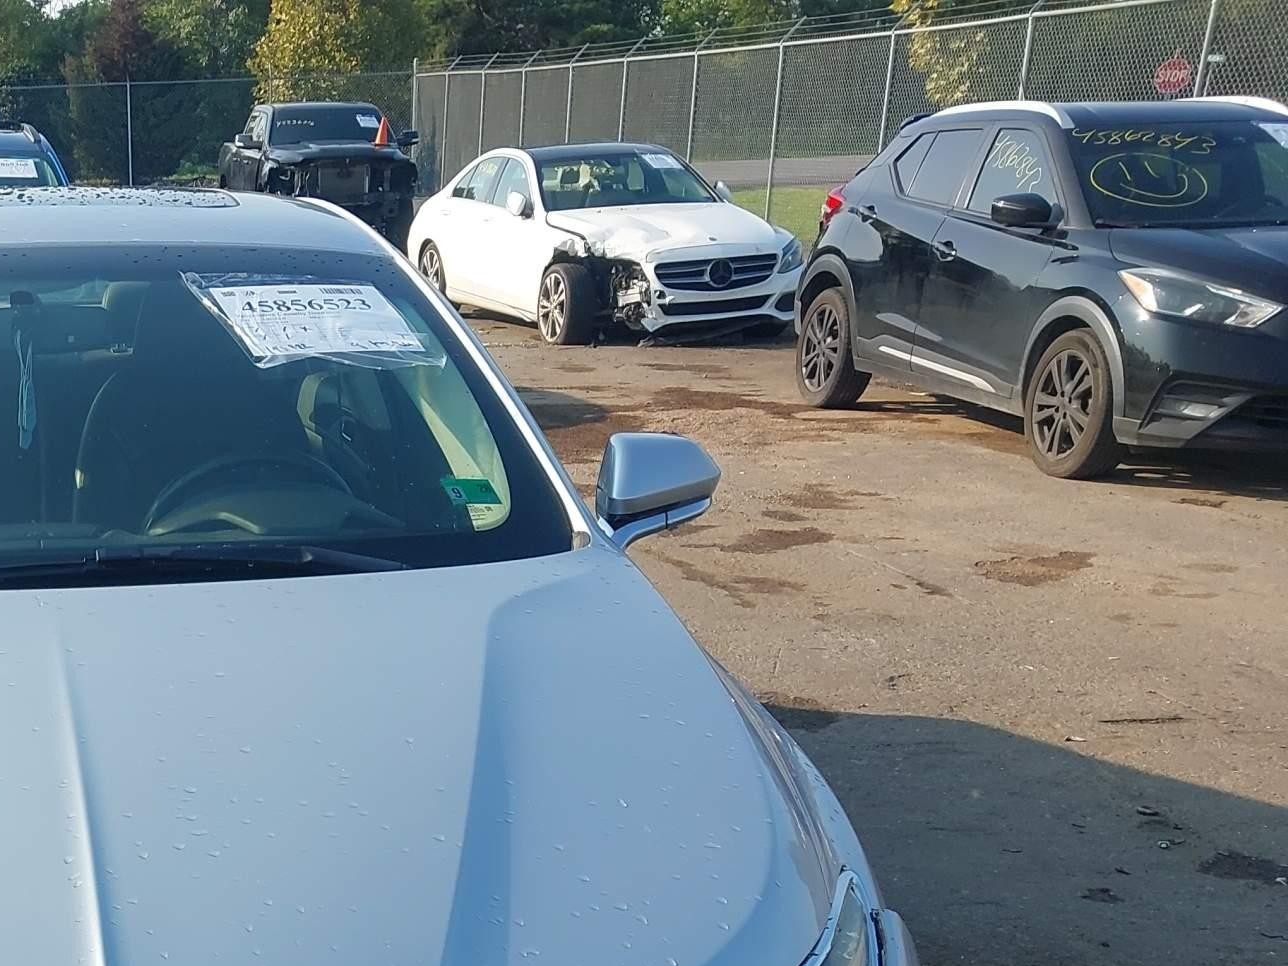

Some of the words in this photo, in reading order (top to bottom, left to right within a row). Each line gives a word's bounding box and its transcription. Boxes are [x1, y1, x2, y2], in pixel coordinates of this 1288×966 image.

[1158, 70, 1188, 82] STOP
[1071, 127, 1216, 153] 45862843
[241, 298, 372, 313] 45856523
